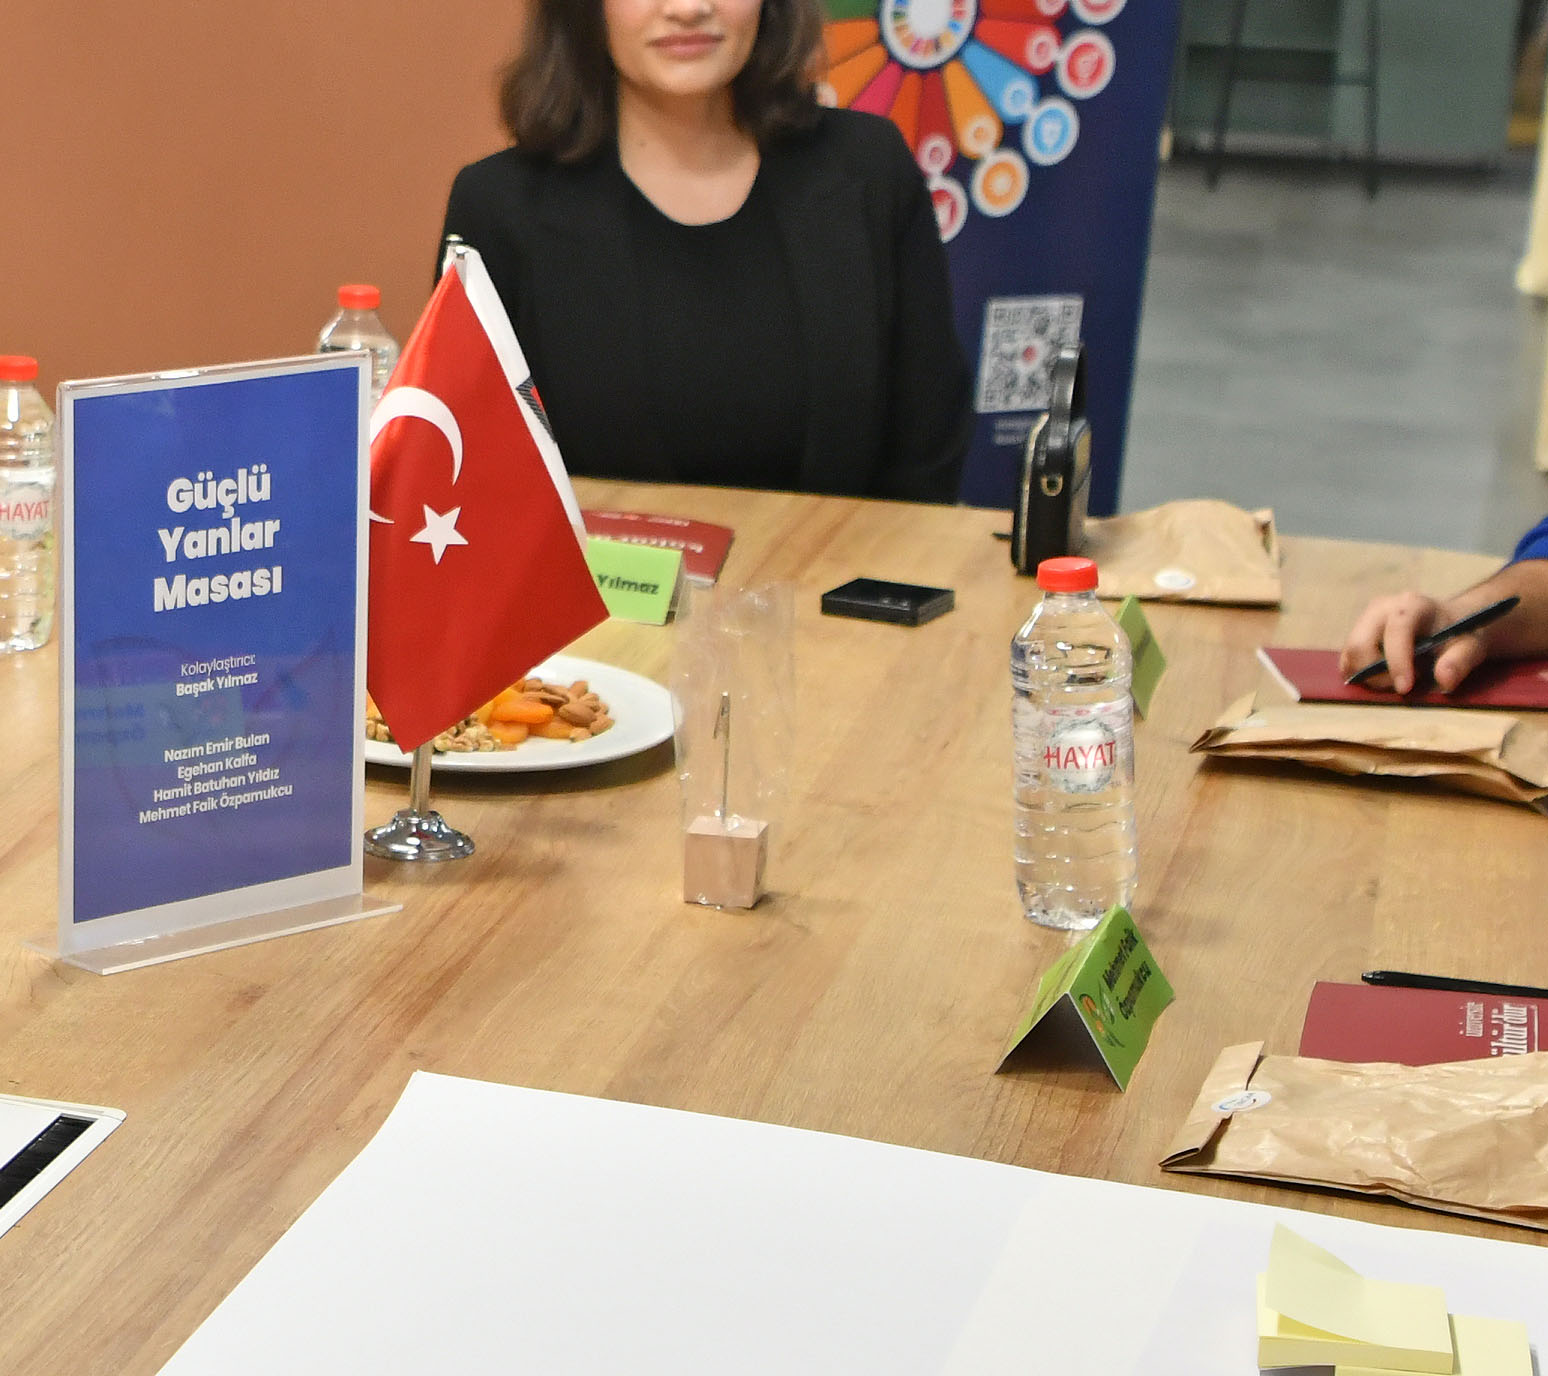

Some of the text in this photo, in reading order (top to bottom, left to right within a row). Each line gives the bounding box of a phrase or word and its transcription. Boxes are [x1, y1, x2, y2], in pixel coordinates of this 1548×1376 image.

[167, 463, 271, 519] Güçlü
[158, 517, 280, 563] Yanlar
[154, 566, 282, 613] Masası
[597, 574, 659, 595] Yılmaz
[176, 672, 258, 698] Başak Yılmaz
[164, 732, 270, 763] Nazım Emir Bulan
[1043, 740, 1116, 770] HAYAT
[177, 753, 257, 782] Egehan Kalfa
[154, 767, 280, 802] Hamit Batuhan Yıldız
[139, 784, 293, 824] Mehmet Faik Özpamukcu
